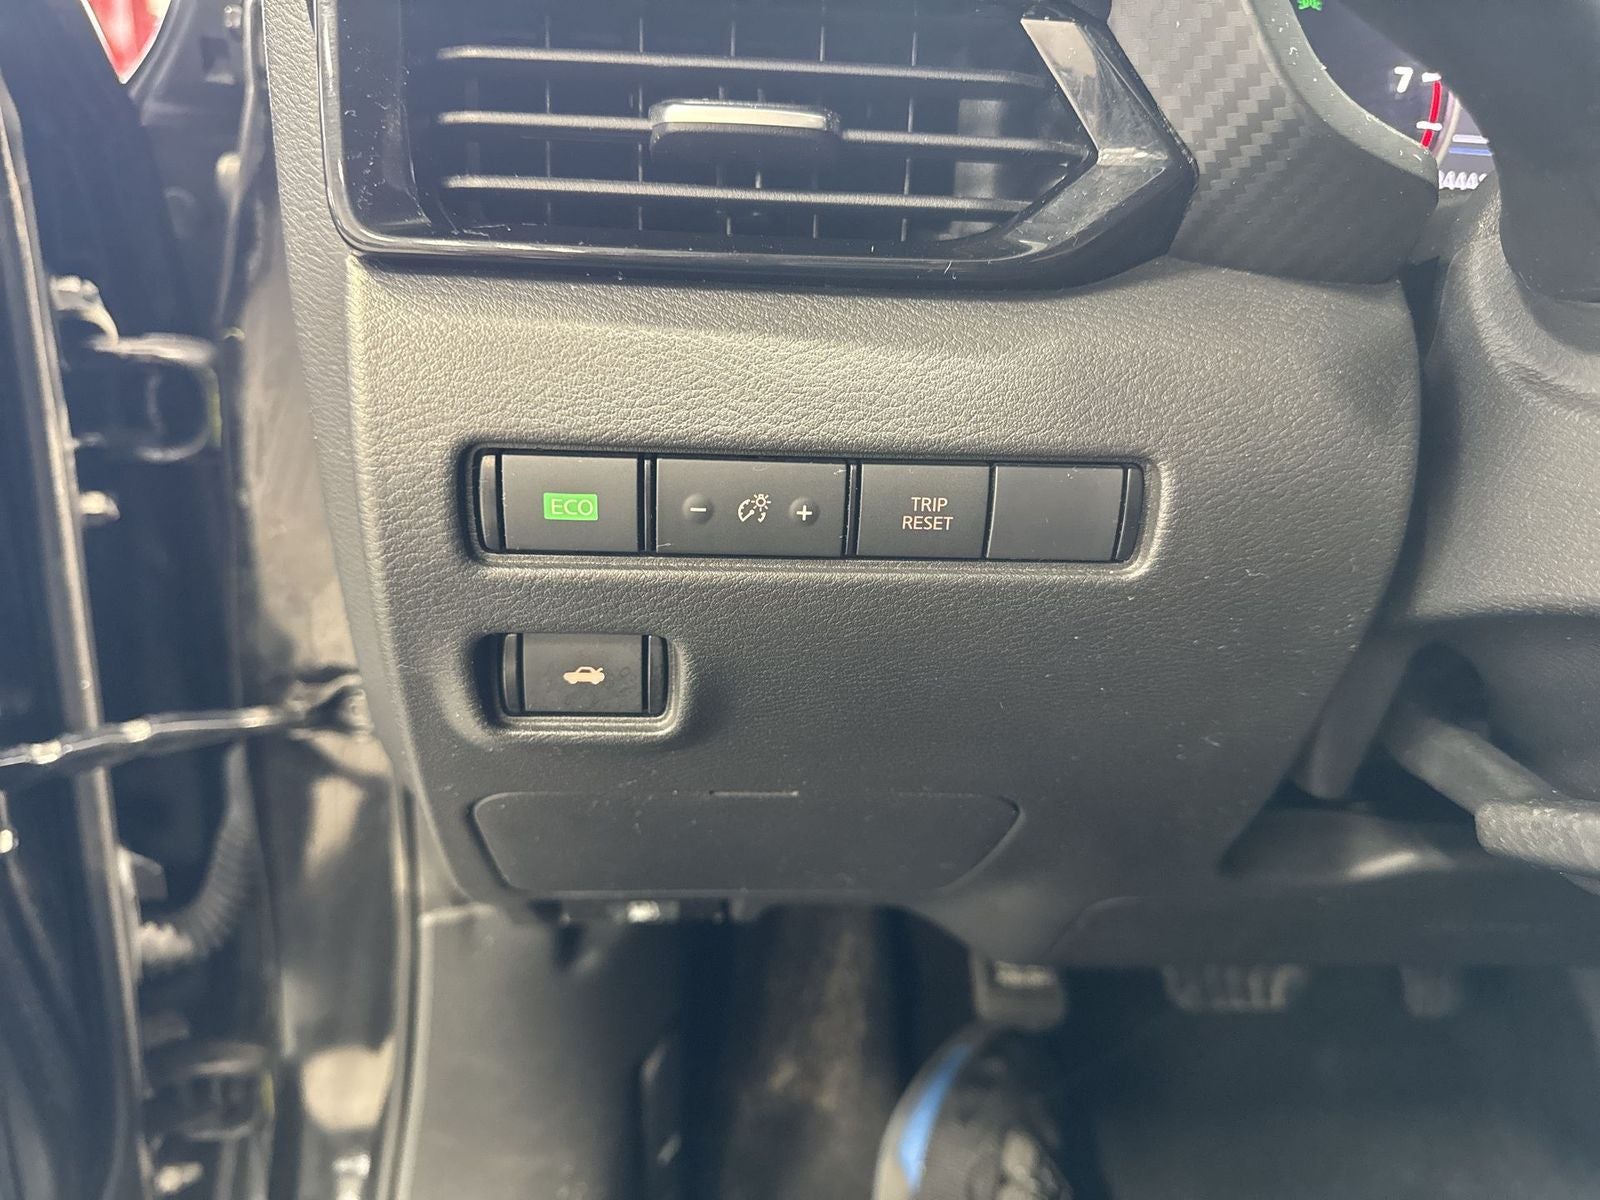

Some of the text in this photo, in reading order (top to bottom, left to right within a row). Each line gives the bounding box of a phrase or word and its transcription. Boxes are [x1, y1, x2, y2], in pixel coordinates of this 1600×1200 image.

[1394, 66, 1413, 93] 7
[551, 498, 594, 516] ECO
[911, 496, 948, 512] TRIP
[902, 515, 954, 530] RESET
